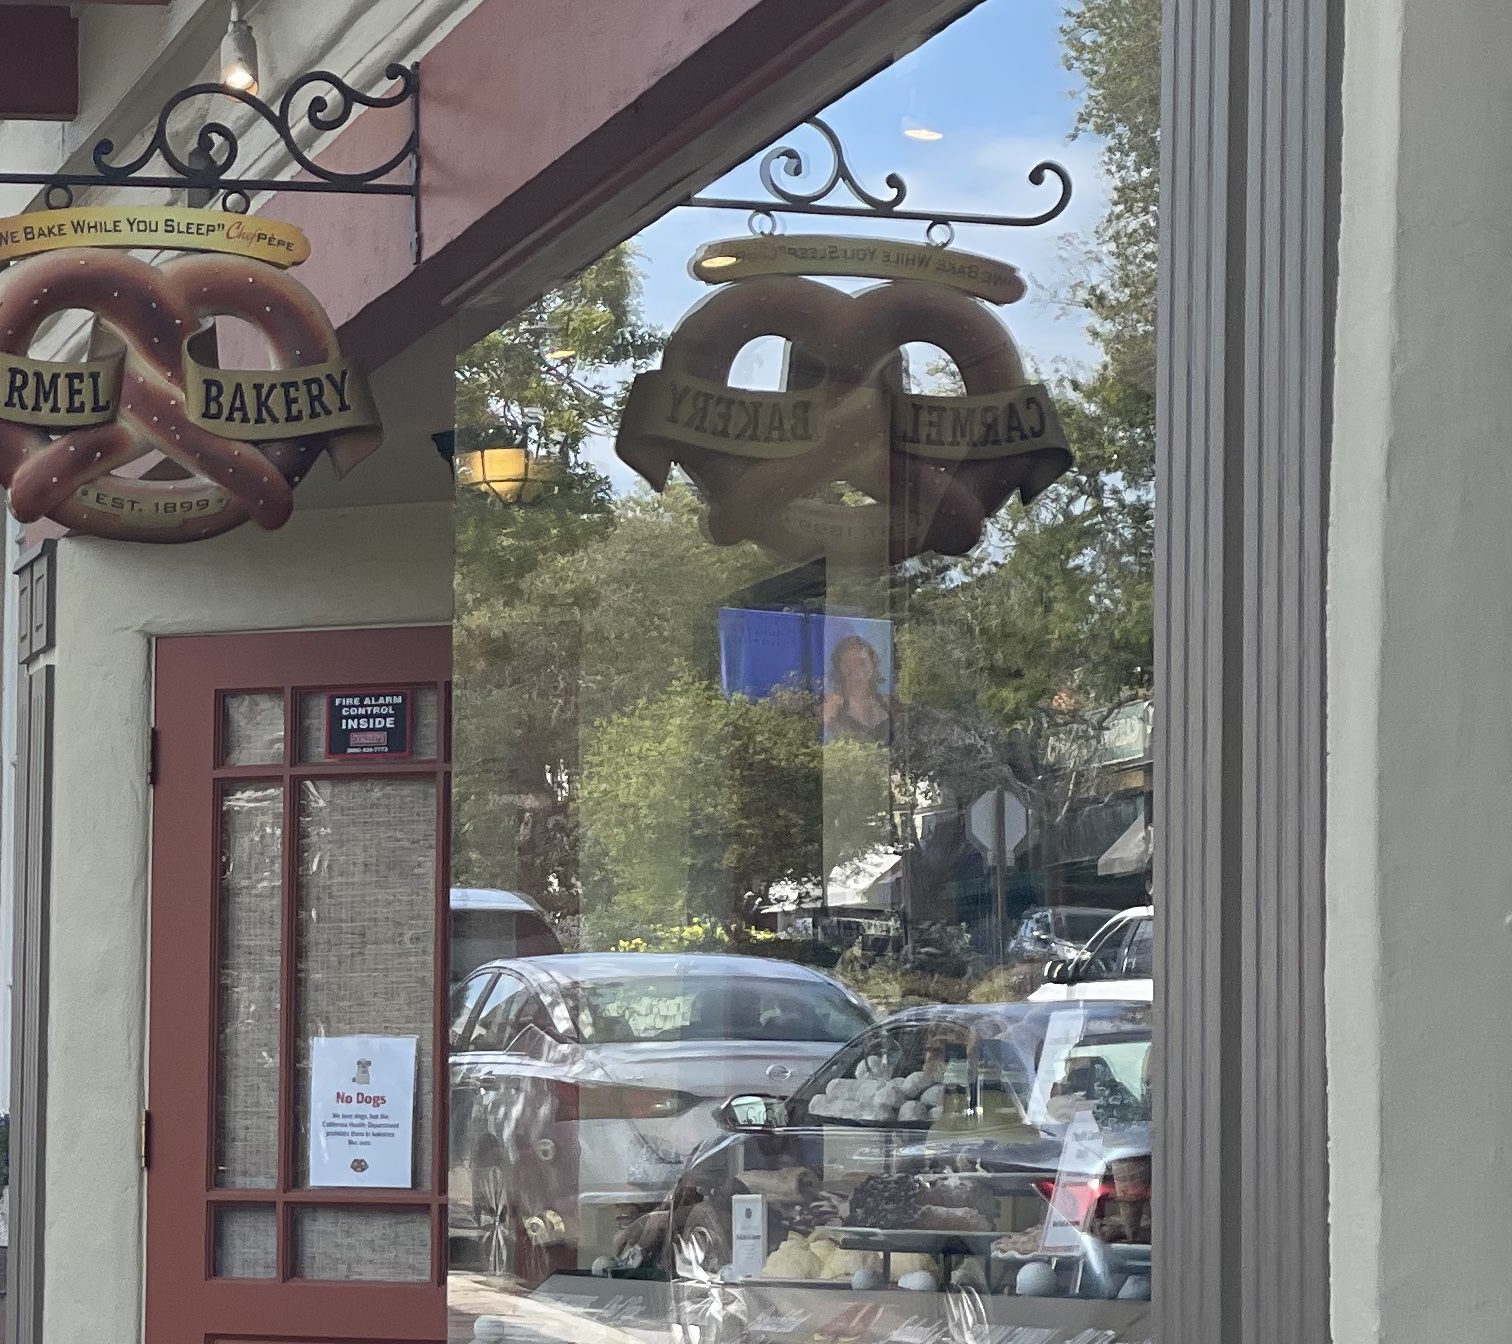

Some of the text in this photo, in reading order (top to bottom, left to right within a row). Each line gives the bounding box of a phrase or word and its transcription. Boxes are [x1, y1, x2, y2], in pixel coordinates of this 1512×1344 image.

[24, 224, 67, 241] BAKE
[71, 219, 122, 235] WHILE
[126, 218, 159, 233] YOU
[201, 369, 353, 425] BAKERY
[95, 492, 211, 514] EST. 1899
[335, 695, 403, 706] FIRE ALARM
[341, 706, 395, 716] CONTROL
[341, 717, 395, 729] INSIDE
[336, 1091, 387, 1108] No Dogs
